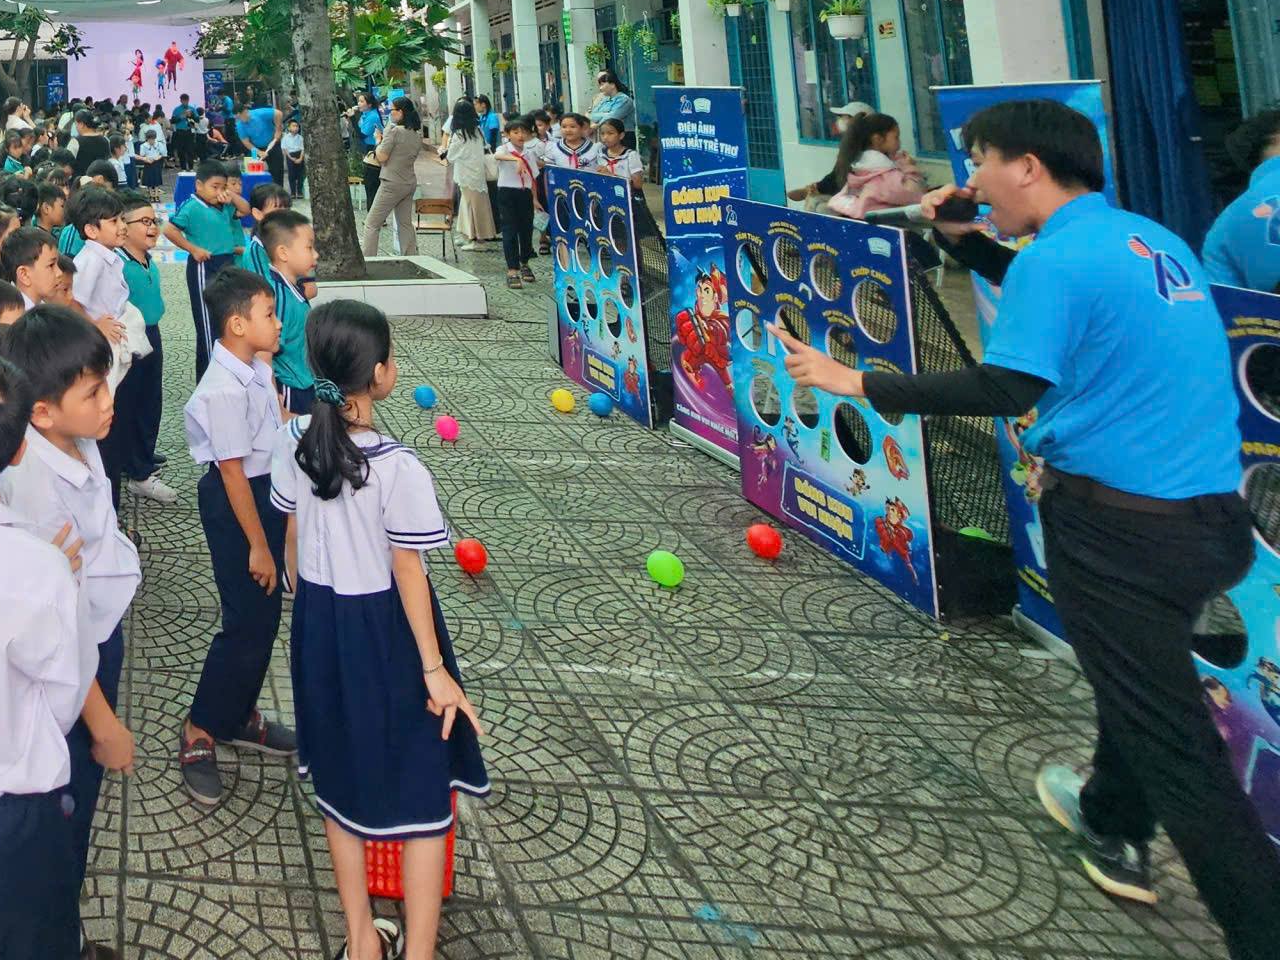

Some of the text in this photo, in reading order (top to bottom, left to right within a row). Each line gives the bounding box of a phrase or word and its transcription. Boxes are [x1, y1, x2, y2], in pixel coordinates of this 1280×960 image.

[678, 121, 715, 136] ĐIỆN ẢNH
[661, 134, 739, 158] TRONG MẮT TRẺ THƠ
[696, 203, 722, 226] NHỘ
